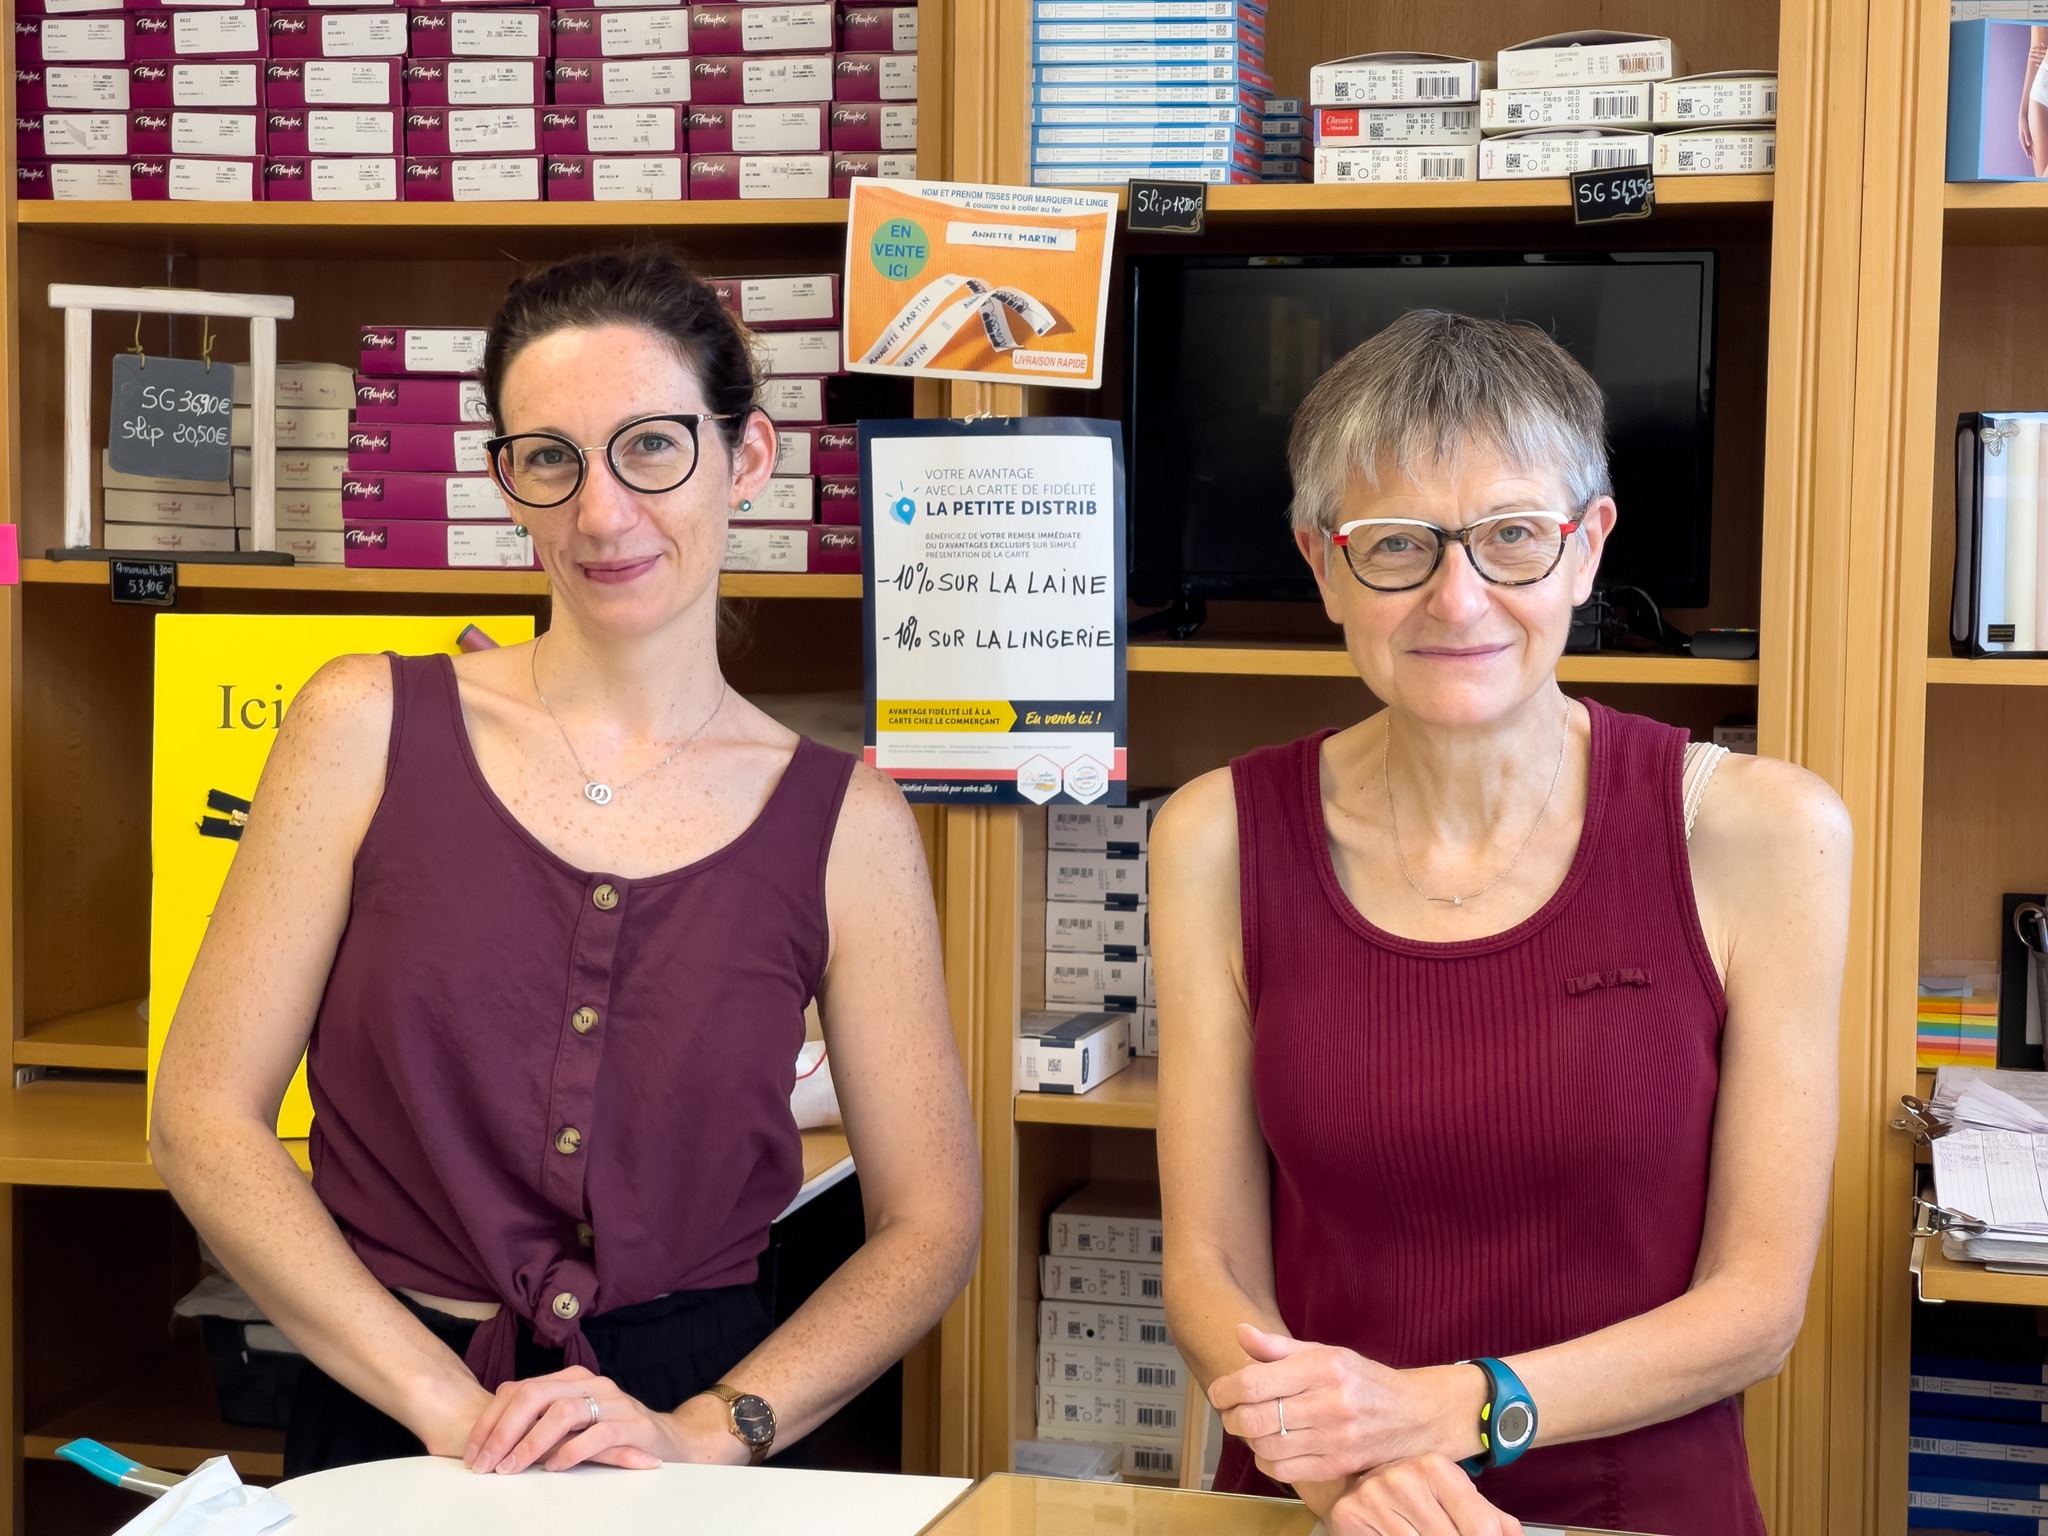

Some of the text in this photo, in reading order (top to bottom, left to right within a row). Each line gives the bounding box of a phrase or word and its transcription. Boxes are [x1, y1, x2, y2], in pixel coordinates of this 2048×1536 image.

[413, 16, 444, 28] Playtex
[558, 18, 590, 31] Playtex
[694, 13, 728, 26] Playtex
[846, 11, 880, 26] Playtex
[137, 19, 167, 32] Playtex
[273, 19, 305, 32] Playtex
[134, 67, 165, 80] Playtex
[268, 67, 299, 79] Playtex
[410, 67, 440, 79] Playtex
[557, 67, 589, 80] Playtex
[695, 61, 730, 77] Playtex
[838, 60, 871, 75] Playtex
[270, 116, 301, 128] Playtex
[409, 115, 440, 128] Playtex
[544, 114, 576, 127] Playtex
[690, 114, 723, 127] Playtex
[834, 108, 868, 123] Playtex
[136, 116, 167, 129] Playtex
[130, 163, 163, 175] Playtex
[270, 164, 302, 177] Playtex
[407, 165, 439, 177] Playtex
[549, 163, 582, 175] Playtex
[693, 162, 725, 175] Playtex
[836, 158, 870, 174] Playtex
[922, 188, 1109, 207] NOM ET PRENOM TISSES POUR MARQUER LE LINGE
[1579, 182, 1605, 203] SG
[972, 201, 999, 210] coudre
[1011, 203, 1017, 211] à
[1018, 204, 1039, 213] coller
[1051, 206, 1062, 214] fer
[1138, 188, 1172, 216] Slip
[890, 224, 912, 239] EN
[971, 230, 1057, 244] ANNETTE MARTIN
[874, 243, 925, 259] VENTE
[888, 263, 908, 278] ICI
[898, 296, 931, 332] MARTIN
[363, 334, 394, 347] Playtex
[1014, 353, 1086, 369] LIVRAISON RAPIDE
[141, 386, 231, 416] SG 36,90€
[358, 387, 396, 402] Playtex
[122, 415, 229, 447] Slip 20,50€
[350, 435, 388, 449] Playtex
[820, 435, 853, 448] Playtex
[925, 468, 1034, 480] VOTRE AVANTAGE
[344, 482, 381, 497] Playtex
[823, 484, 856, 497] Playtex
[925, 482, 1097, 496] AVEC LA CARTE DE FIDÉLITÉ
[926, 500, 1097, 516] LA PETITE DISTRIB
[346, 530, 384, 544] Playtex
[822, 534, 855, 547] Playtex
[925, 531, 966, 540] BÉNÉFICIEZ
[968, 532, 978, 540] DE
[980, 532, 1006, 540] VOTRE
[1038, 530, 1082, 539] IMMÉDIATE
[938, 541, 988, 549] D'AVANTAGES
[990, 541, 1031, 549] EXCLUSIFS
[1032, 541, 1048, 549] SUR
[1049, 541, 1077, 549] SIMPLE
[925, 550, 979, 559] PRÉSENTATION
[981, 551, 992, 559] DE
[128, 578, 166, 596] 53,10€
[938, 573, 978, 593] SUR
[989, 571, 1017, 594] LA
[928, 629, 965, 648] SUR
[976, 629, 1001, 649] LA
[217, 683, 283, 730] Ici
[888, 707, 991, 716] AVANTAGE FIDÉLITÉ LIÉ À LA
[888, 717, 1000, 727] CARTE CHEZ LE COMMERÇANT
[1025, 711, 1102, 726] En vente ici !
[948, 785, 962, 794] par
[962, 784, 979, 793] votre
[979, 783, 994, 793] ville
